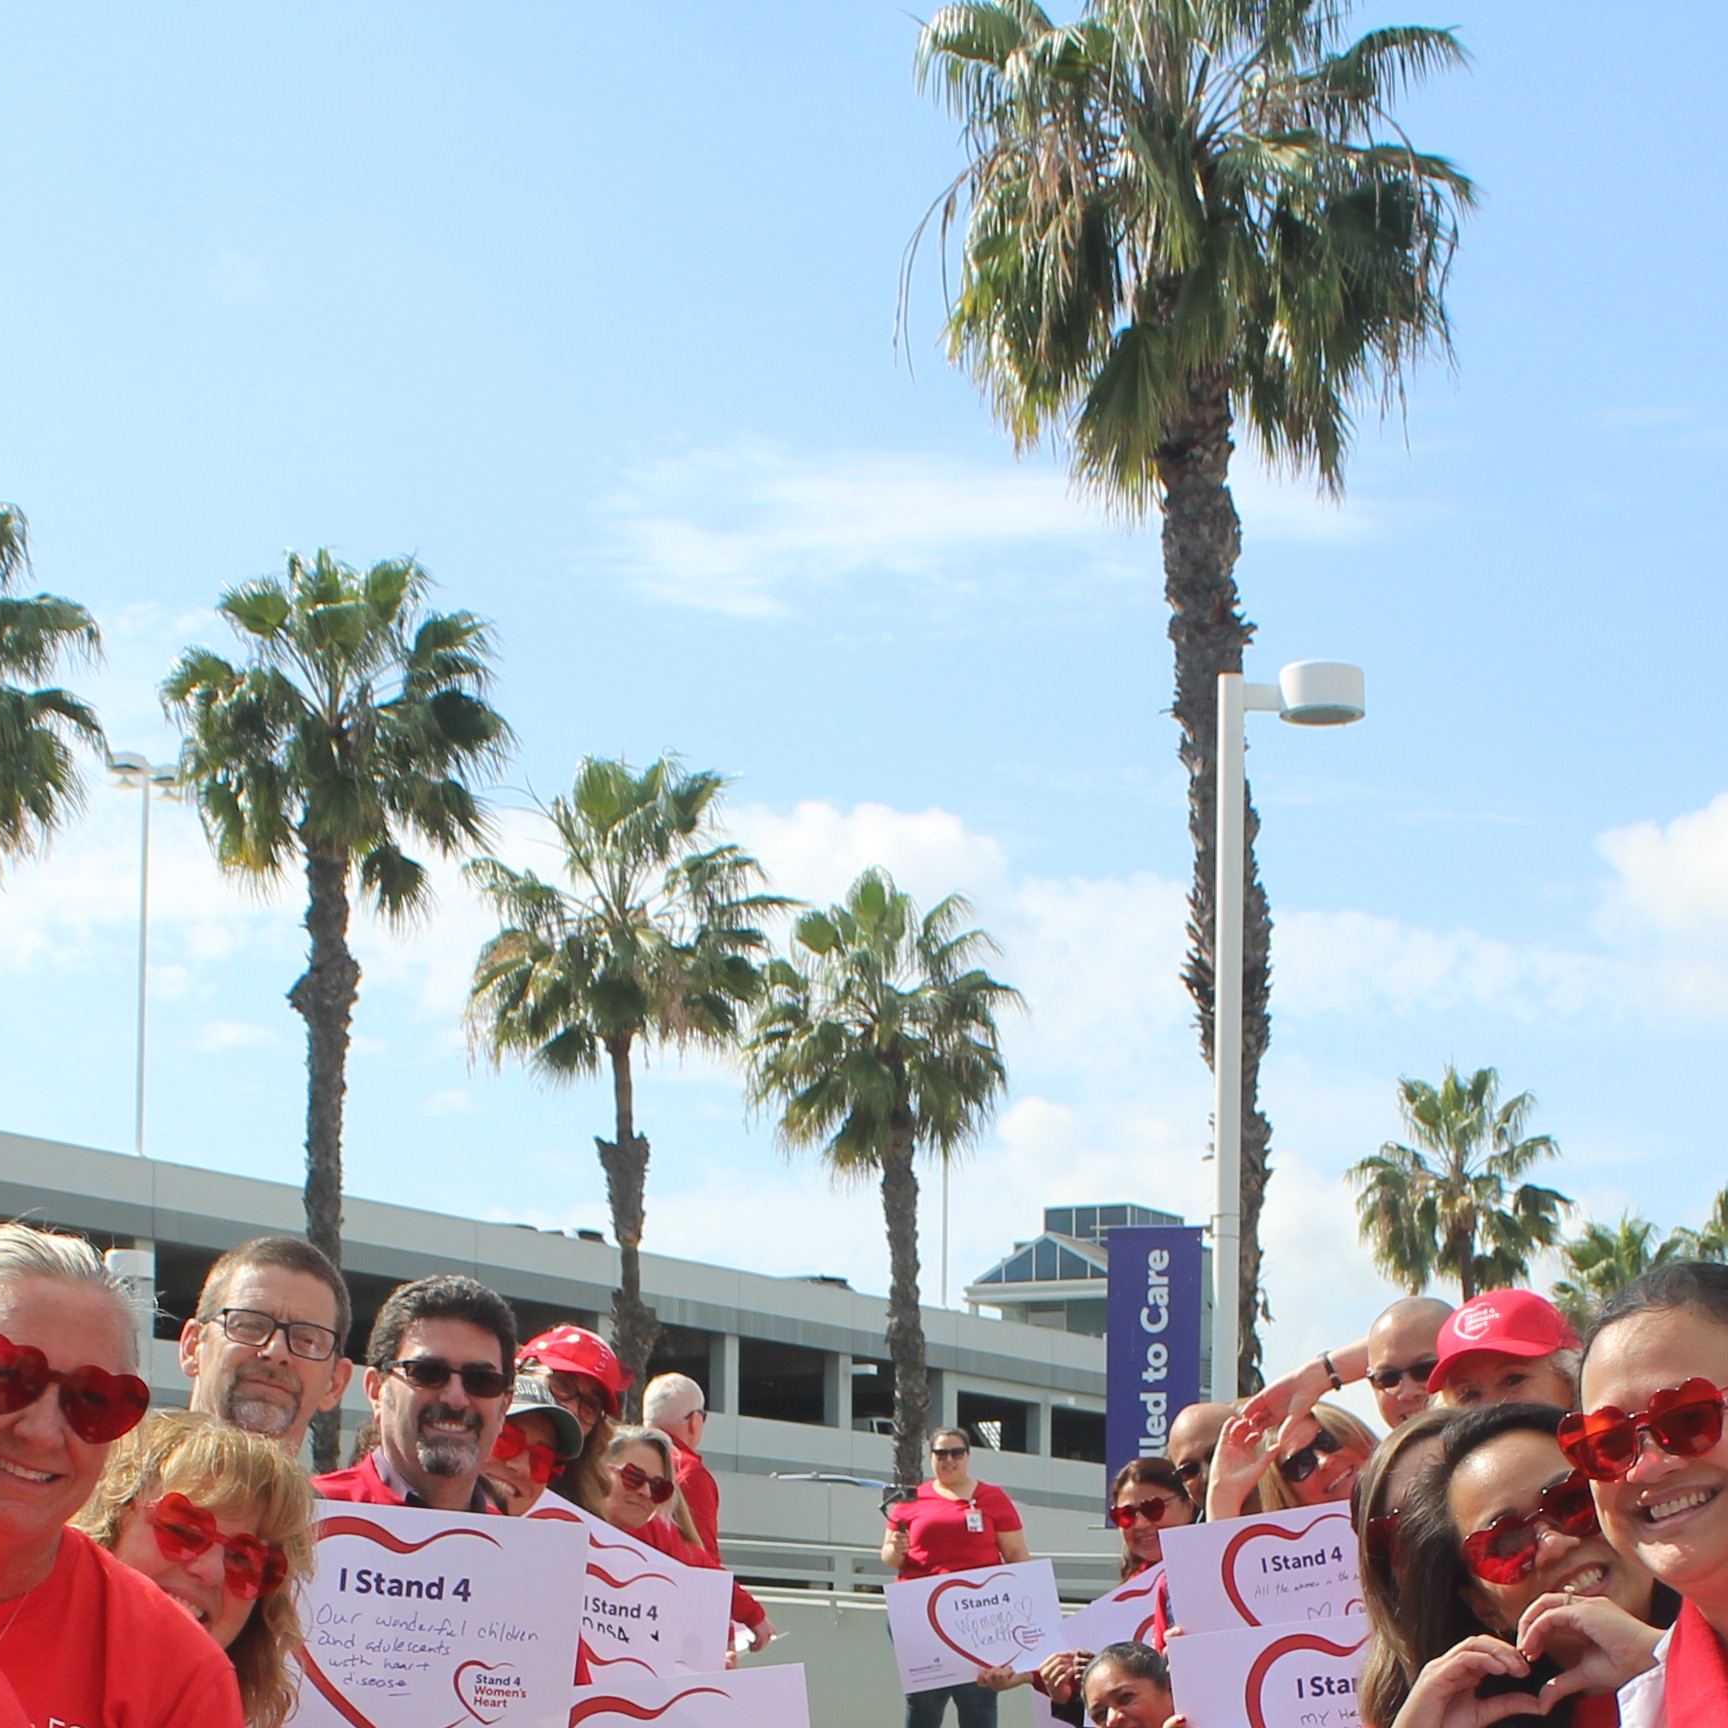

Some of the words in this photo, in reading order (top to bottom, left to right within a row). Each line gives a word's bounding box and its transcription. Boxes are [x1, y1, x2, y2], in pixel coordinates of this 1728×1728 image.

[1139, 1249, 1170, 1334] Care
[1141, 1342, 1169, 1382] to
[1261, 1557, 1268, 1574] I
[1271, 1548, 1327, 1572] Stand
[1330, 1546, 1343, 1562] 4
[338, 1567, 348, 1593] I
[355, 1569, 445, 1601] Stand
[452, 1578, 472, 1603] 4
[591, 1597, 642, 1620] Stand
[646, 1605, 658, 1621] 4
[954, 1600, 959, 1612] I
[961, 1594, 999, 1611] Stand
[1002, 1592, 1011, 1604] 4
[316, 1603, 362, 1625] Our
[375, 1611, 467, 1638] wonderful
[477, 1621, 540, 1642] children
[475, 1673, 511, 1687] Stand
[513, 1676, 521, 1687] 4
[1297, 1678, 1304, 1699] I
[473, 1696, 508, 1708] Heart
[474, 1686, 527, 1699] Women's
